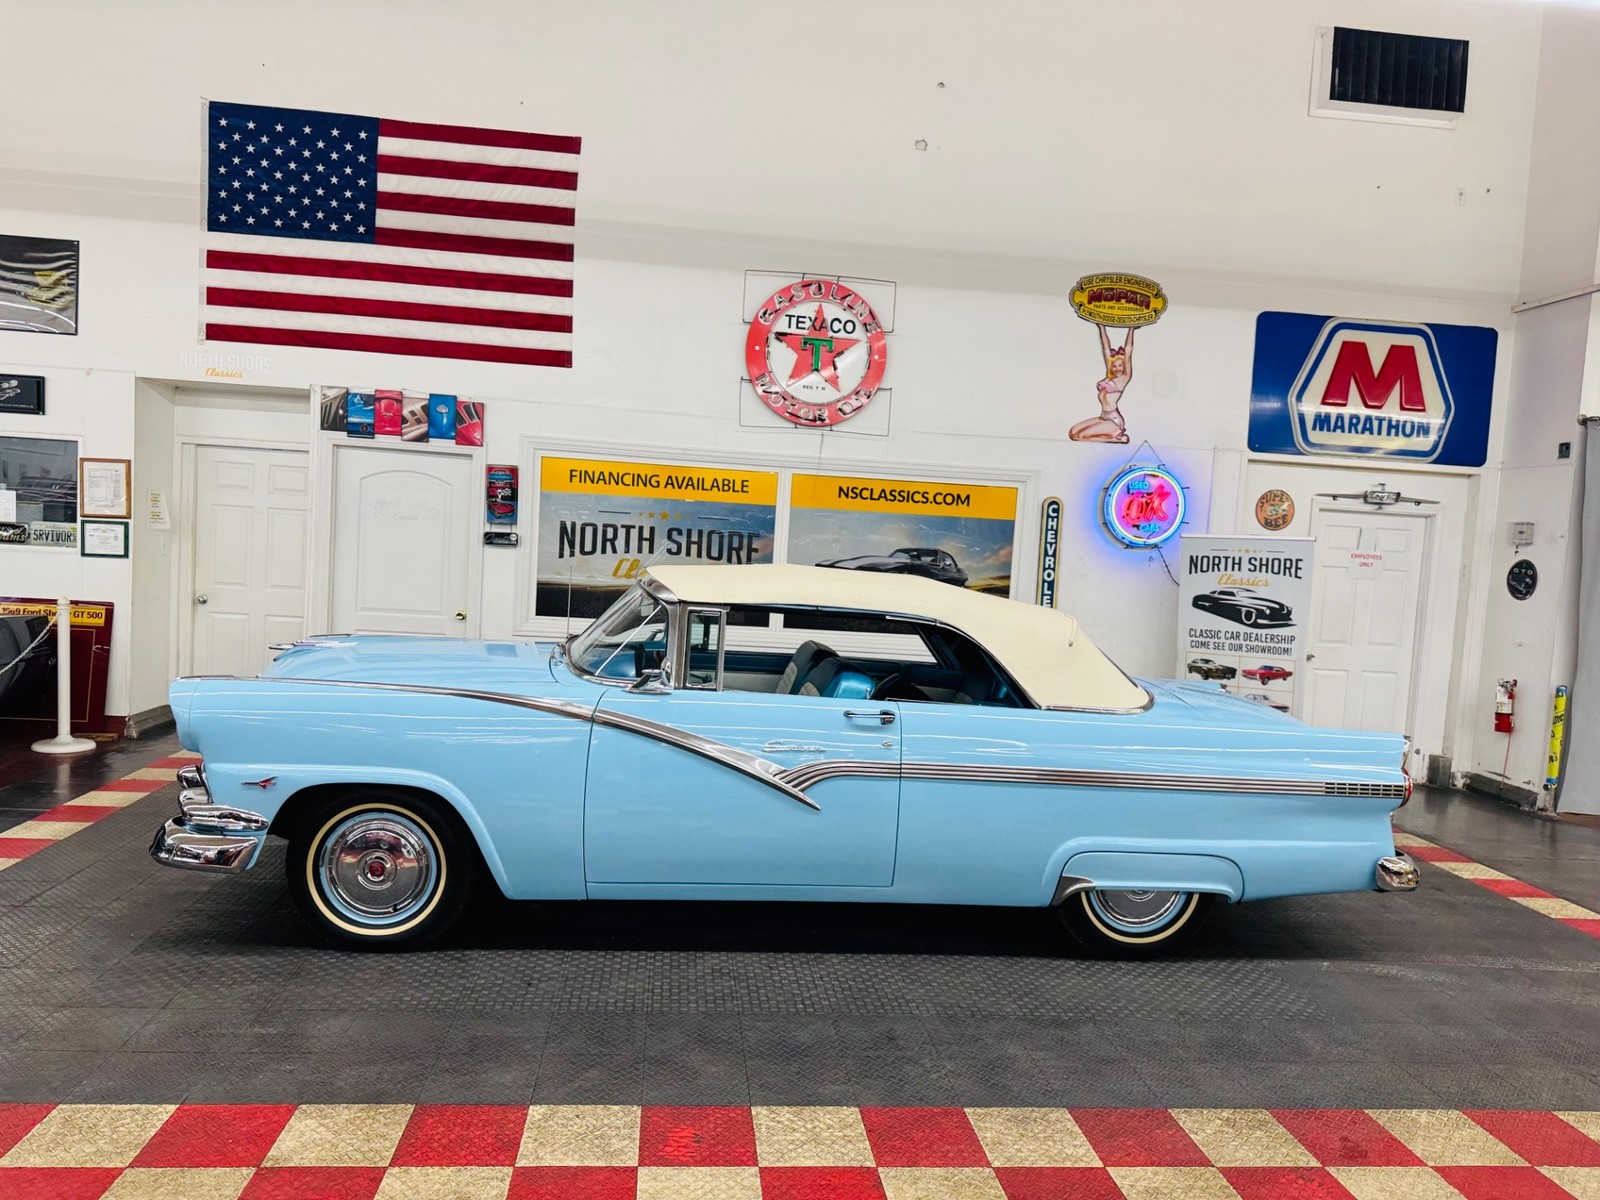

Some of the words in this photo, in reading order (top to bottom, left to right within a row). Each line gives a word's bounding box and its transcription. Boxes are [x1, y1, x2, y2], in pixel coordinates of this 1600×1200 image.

[1083, 278, 1094, 287] USE
[1095, 276, 1122, 284] CHRYSLER
[1124, 277, 1155, 292] ENGINEERED
[1087, 287, 1151, 310] MOPAR
[785, 314, 856, 335] TEXACO
[179, 351, 224, 368] NORTH
[227, 353, 272, 374] SHORE
[801, 337, 834, 371] T
[204, 367, 244, 378] Classics
[1320, 340, 1426, 413] M
[756, 373, 829, 423] MOTOR
[1311, 412, 1430, 439] MARATHON
[569, 469, 660, 489] FINANCING
[664, 475, 750, 493] AVAILABLE
[837, 485, 971, 507] NSCLASSICS.COM
[1123, 484, 1171, 525] OK
[1264, 514, 1288, 528] BEE
[33, 529, 72, 543] SRVIVOR
[558, 520, 656, 559] NORTH
[666, 527, 761, 565] SHORE
[1042, 504, 1059, 608] CHEVROLE
[1189, 555, 1242, 575] NORTH
[1247, 556, 1303, 579] SHORE
[1350, 553, 1382, 562] EMPLOYEES
[1217, 573, 1271, 588] Classics
[1513, 567, 1534, 576] GTO
[73, 611, 86, 619] GT
[87, 611, 103, 620] 500
[1188, 628, 1221, 640] CLASSIC
[1224, 630, 1240, 641] CAR
[1243, 632, 1296, 646] DEALERSHIP
[1190, 640, 1210, 650] COME
[1212, 641, 1226, 651] SEE
[1228, 642, 1242, 652] OUR
[1244, 644, 1292, 657] SHOWROOM!
